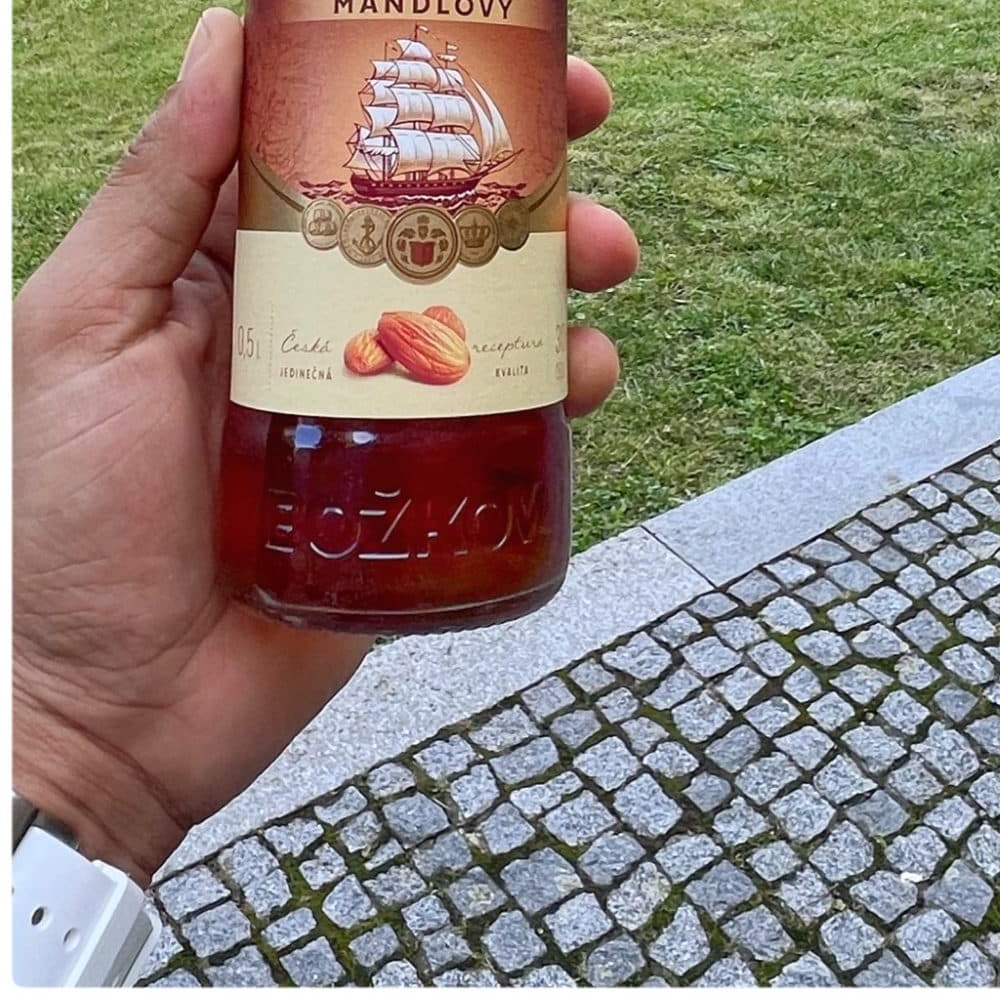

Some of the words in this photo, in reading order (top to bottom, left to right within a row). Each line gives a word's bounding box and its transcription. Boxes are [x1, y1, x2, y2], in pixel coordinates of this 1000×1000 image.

[281, 328, 331, 354] Česká
[280, 366, 332, 381] JEDINEČNÁ
[495, 365, 528, 378] KVALITA
